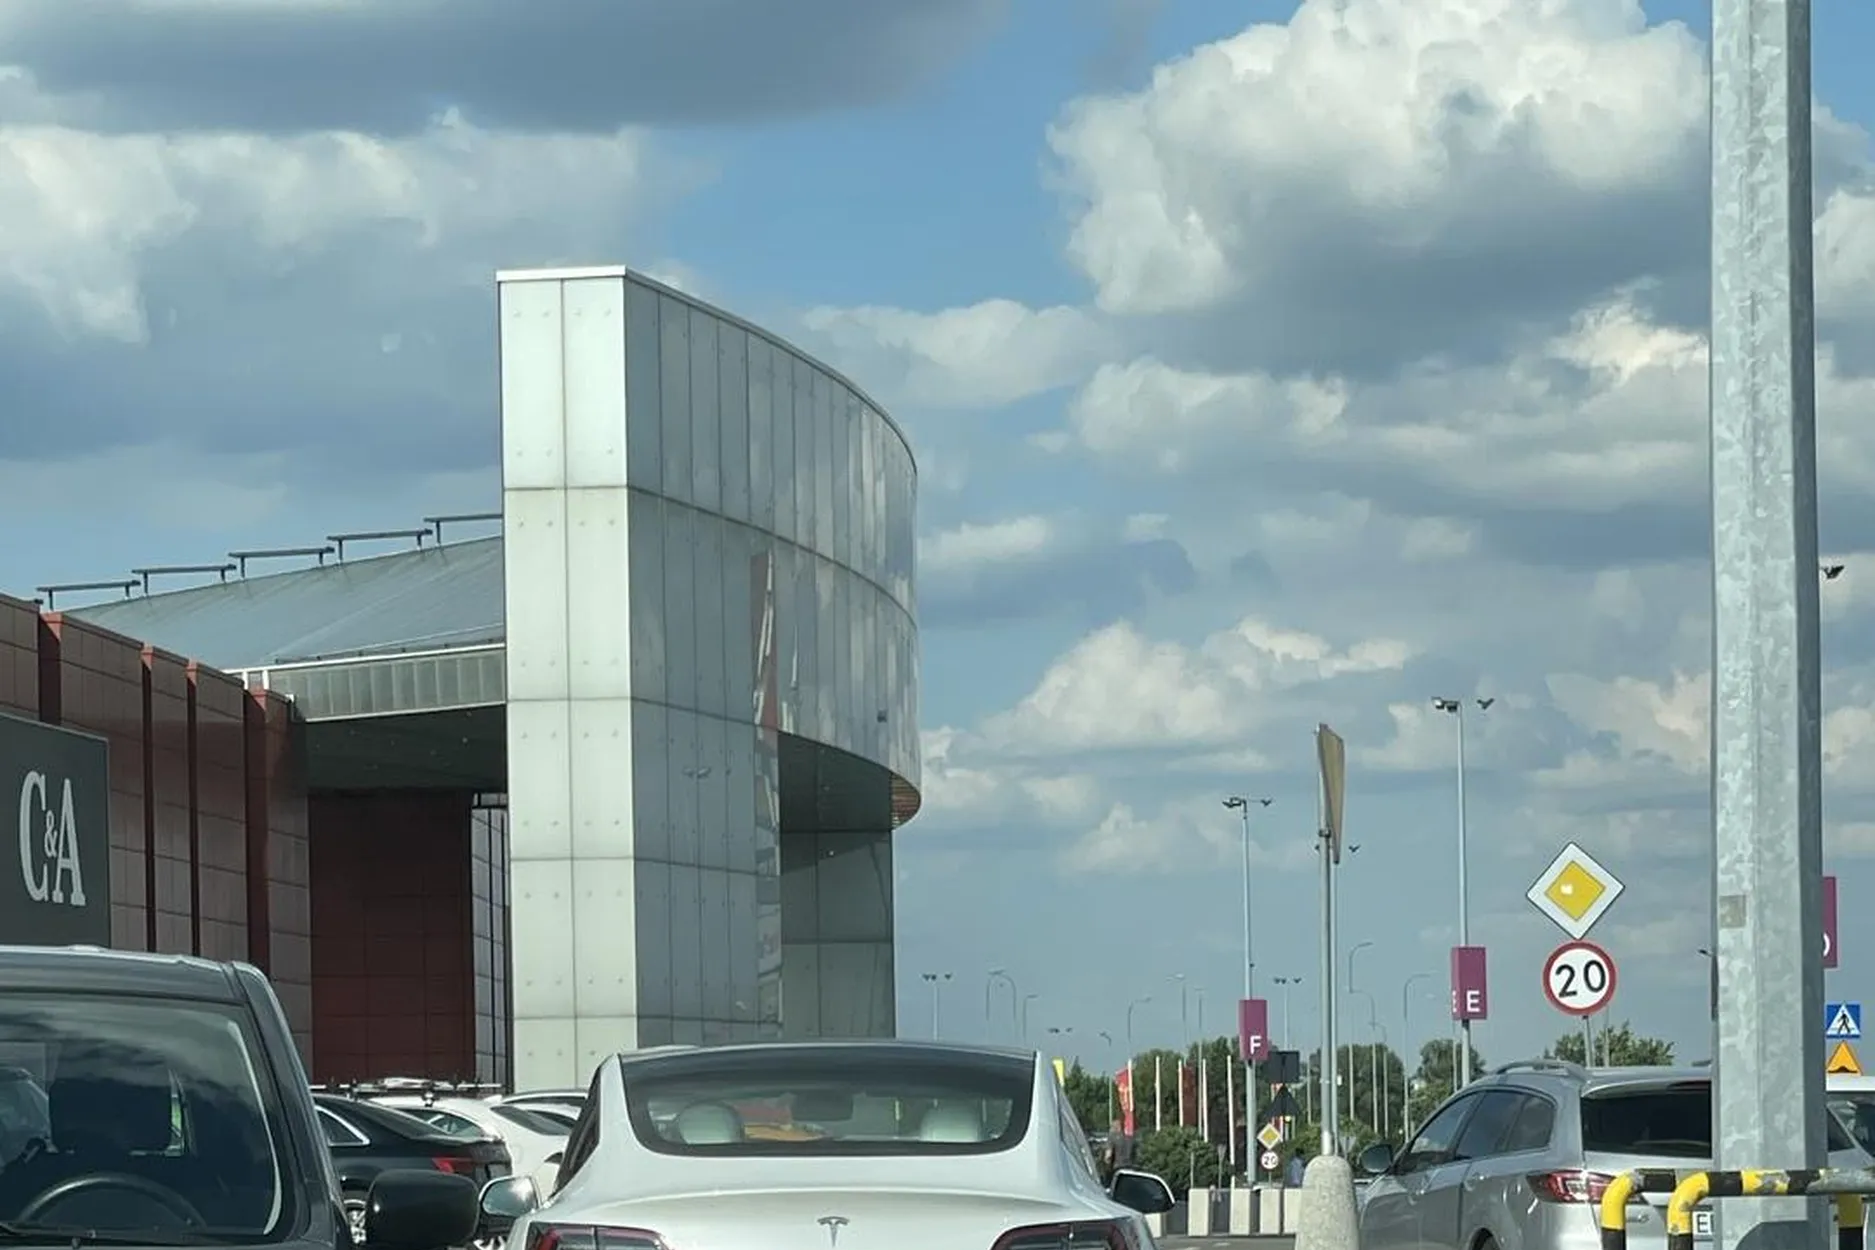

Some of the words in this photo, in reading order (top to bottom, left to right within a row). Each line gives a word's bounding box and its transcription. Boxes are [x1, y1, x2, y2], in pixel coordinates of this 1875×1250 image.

[19, 770, 87, 906] C&A
[1555, 959, 1607, 998] 20
[1466, 990, 1481, 1013] E
[1250, 1035, 1262, 1055] F
